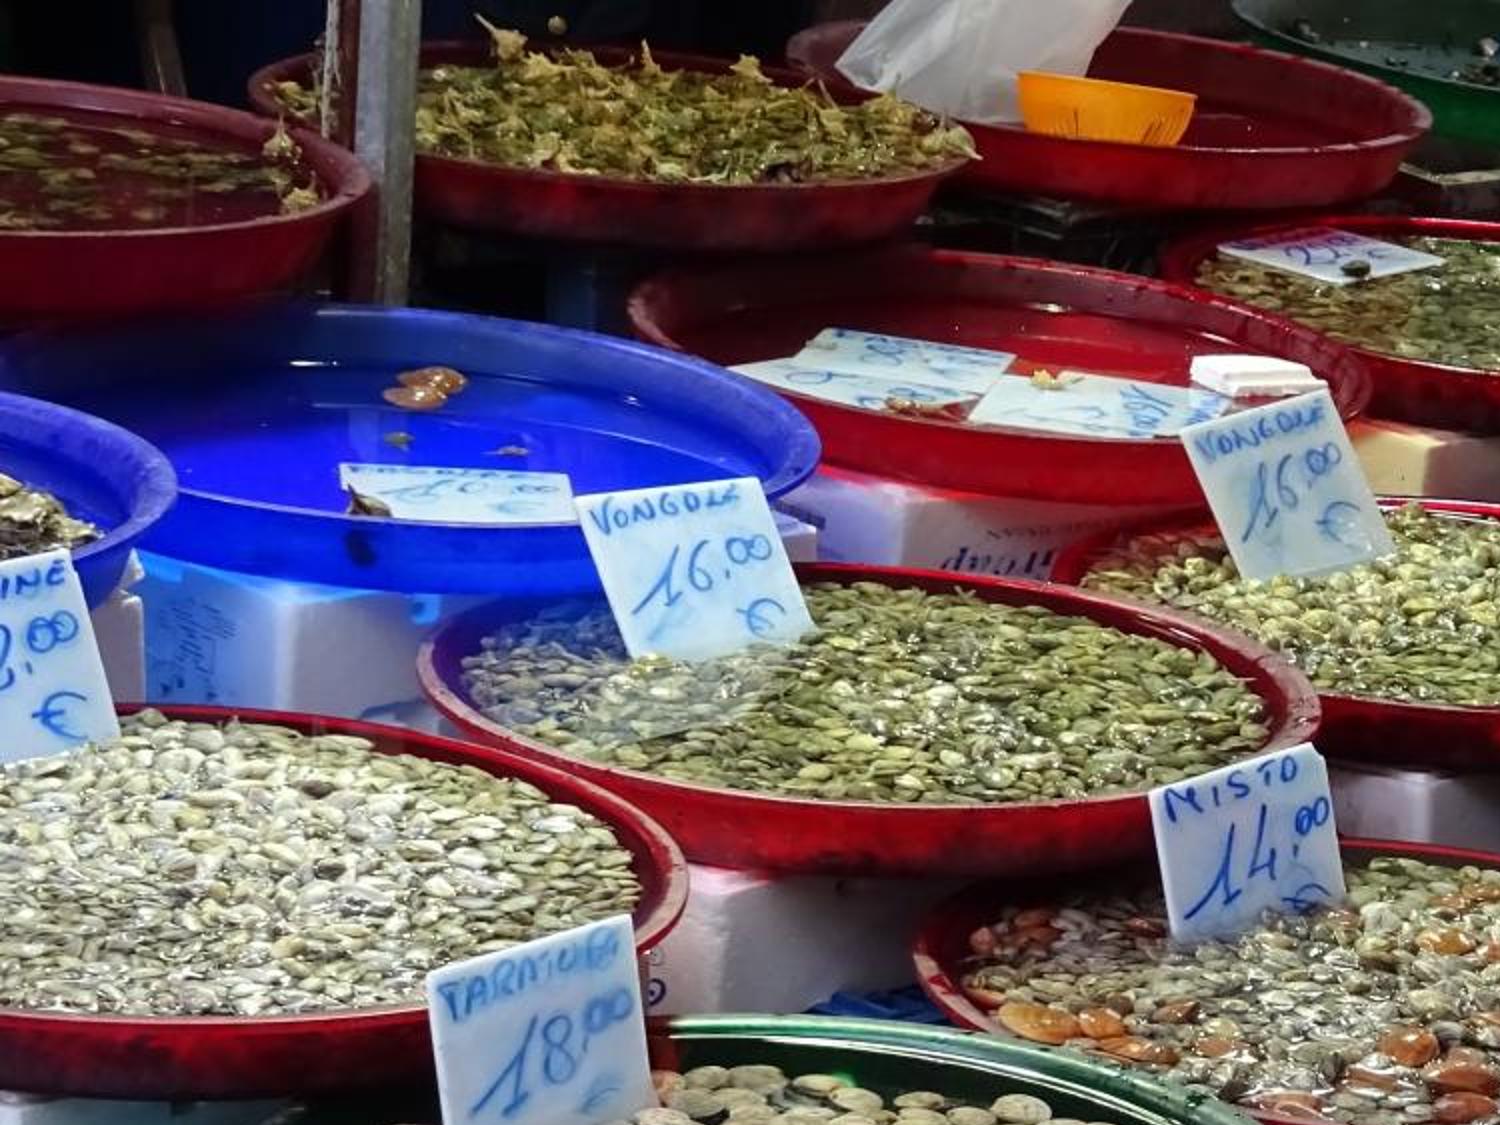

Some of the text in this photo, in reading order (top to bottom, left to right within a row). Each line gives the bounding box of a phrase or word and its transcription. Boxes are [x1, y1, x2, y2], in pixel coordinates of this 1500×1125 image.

[1194, 398, 1325, 463] VONGOLE
[588, 483, 740, 536] VONGOLE
[1242, 442, 1342, 543] 16,00
[1316, 501, 1362, 548] €
[632, 534, 773, 616] 16,00
[736, 597, 788, 640] €
[31, 691, 88, 740] €
[1163, 755, 1298, 824] MISTO
[1184, 796, 1330, 920] 14,00
[468, 987, 635, 1118] 18,00
